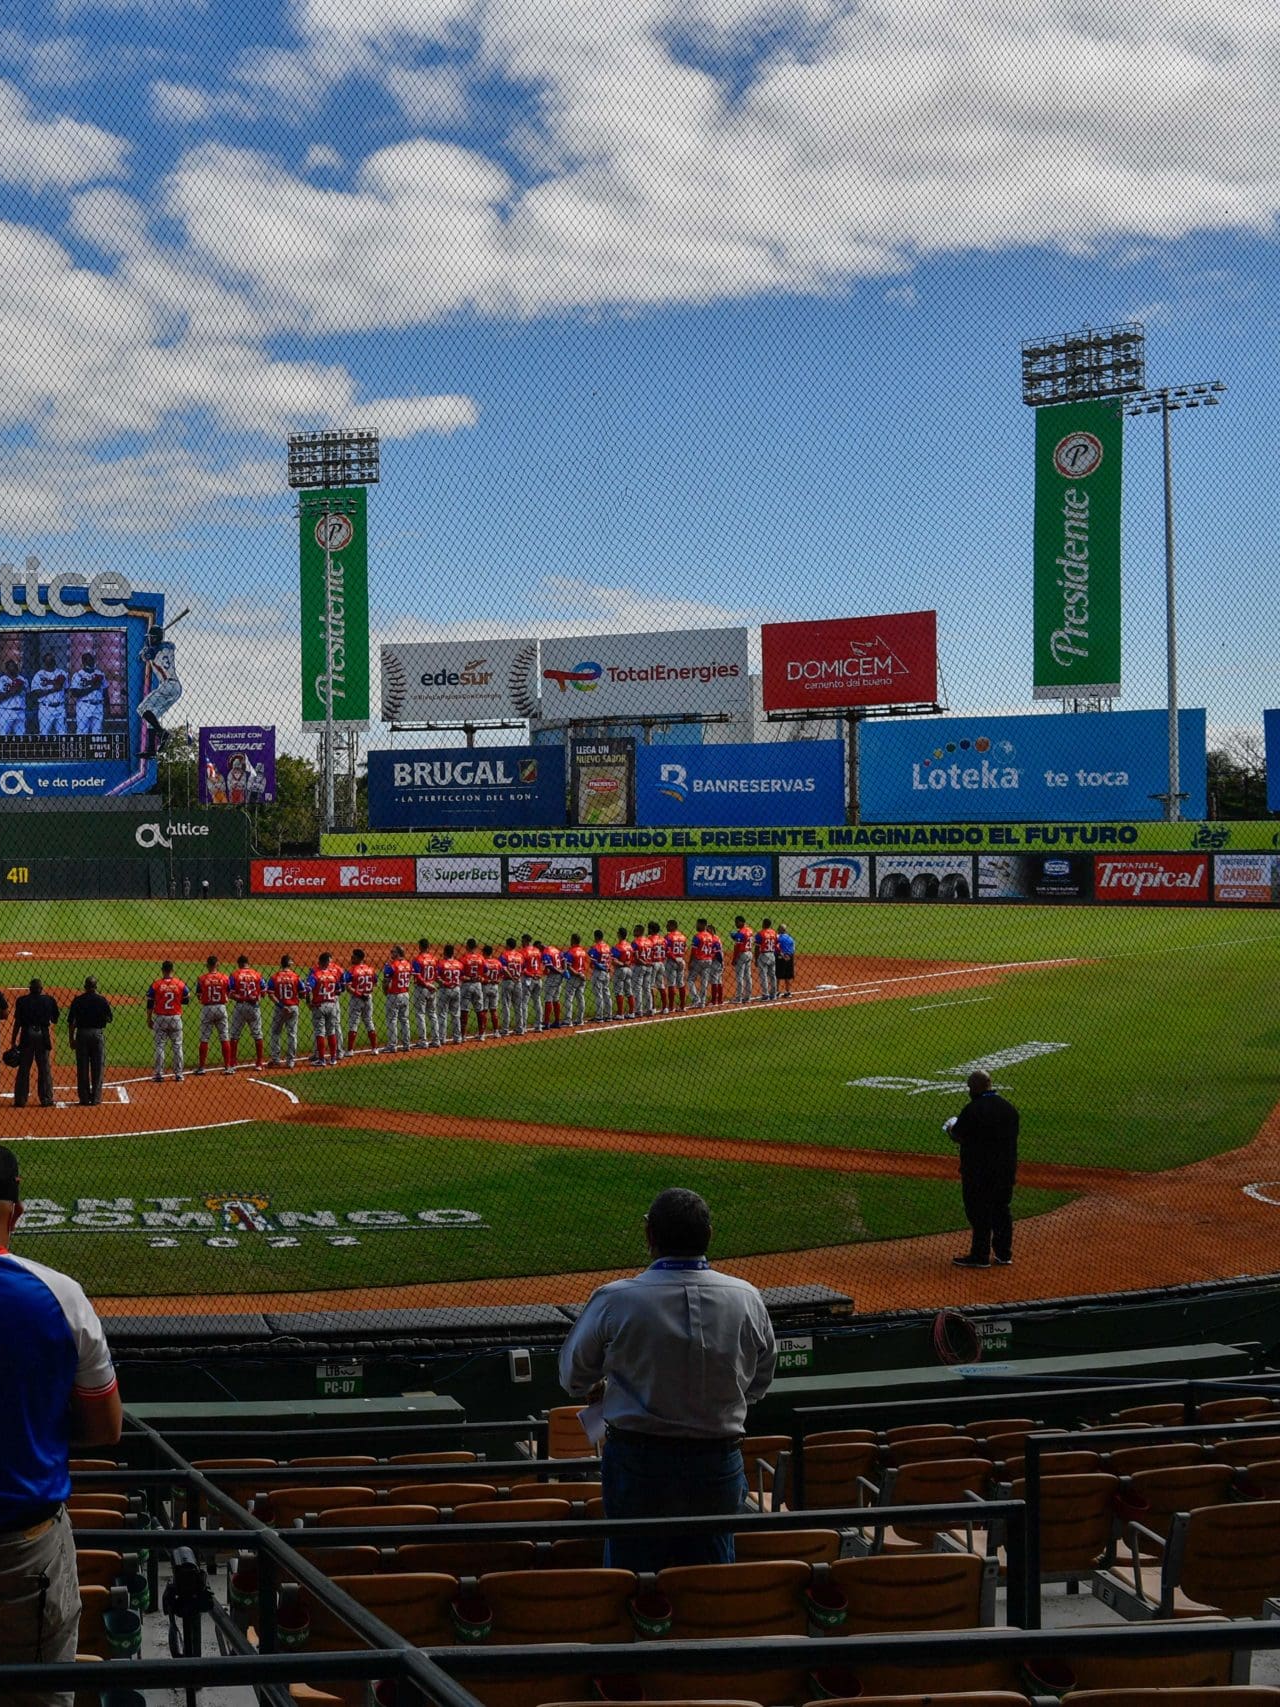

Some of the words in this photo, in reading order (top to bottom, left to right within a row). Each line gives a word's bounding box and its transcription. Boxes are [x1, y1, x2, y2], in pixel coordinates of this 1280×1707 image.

[1050, 487, 1089, 667] Presidente
[606, 661, 740, 684] TotalEnergies
[786, 656, 892, 681] DOMICEM
[421, 669, 493, 686] edesur
[862, 678, 893, 687] bueno
[576, 746, 596, 754] LLEGA
[598, 745, 609, 754] UN
[393, 760, 512, 787] BRUGAL
[912, 760, 1019, 790] Loteka
[1044, 770, 1069, 787] te
[1075, 769, 1129, 787] toca
[38, 778, 49, 787] te
[52, 777, 68, 787] da
[71, 777, 106, 789] poder
[692, 778, 816, 793] BANRESERVAS
[510, 793, 531, 801] RON
[166, 822, 209, 836] altice
[493, 832, 667, 849] CONSTRUYENDO
[672, 832, 696, 847] EL
[701, 829, 823, 850] PRESENTE,
[828, 829, 982, 846] IMAGINANDO
[988, 828, 1017, 845] EL
[1025, 826, 1139, 845] FUTURO
[284, 867, 301, 875] AFP
[360, 867, 377, 875] AFP
[886, 860, 969, 868] TRIANGLE
[6, 867, 29, 884] 411
[283, 875, 326, 887] Crecer
[360, 874, 402, 886] Crecer
[434, 868, 499, 882] SuperBets
[797, 867, 851, 889] LTH
[1098, 862, 1204, 896] Tropical
[358, 975, 373, 991] 25
[398, 972, 410, 988] 55
[207, 985, 221, 1002] 15
[280, 984, 293, 999] 16
[164, 992, 174, 1010] 2
[780, 1340, 793, 1351] LTB
[779, 1353, 808, 1367] PC-05
[324, 1380, 355, 1393] PC-07
